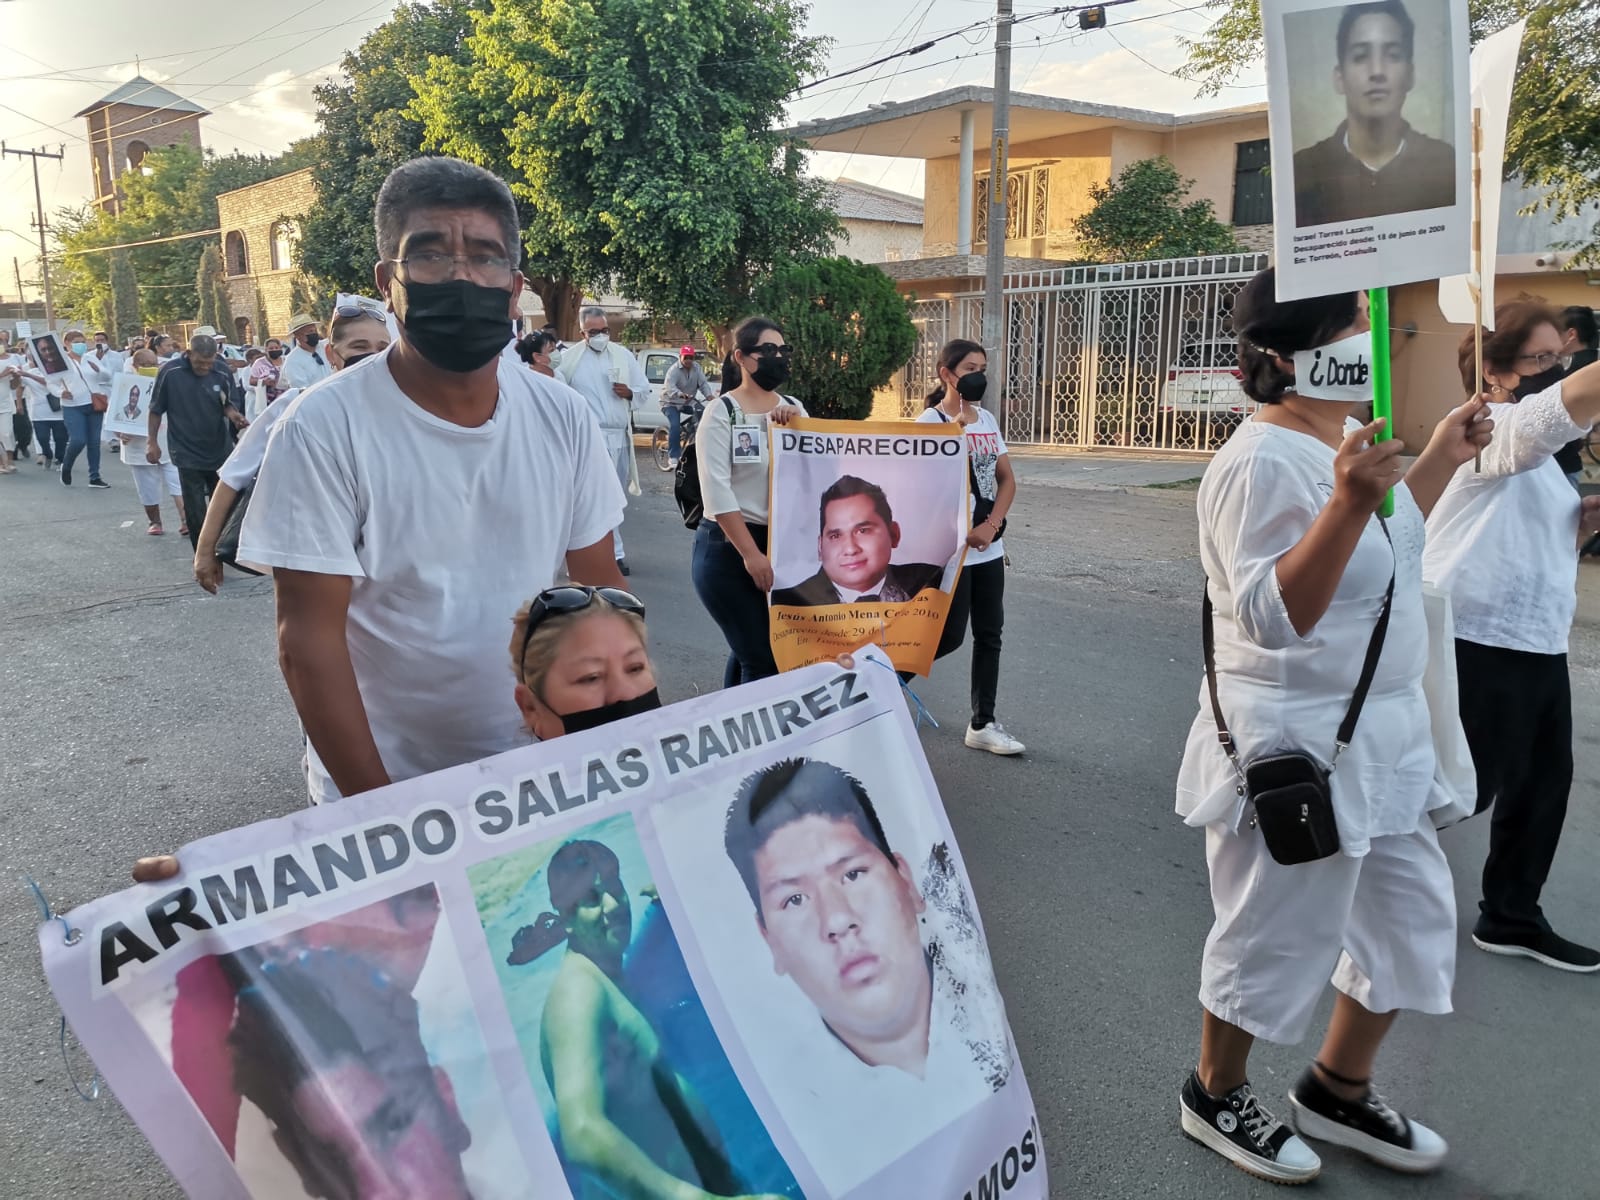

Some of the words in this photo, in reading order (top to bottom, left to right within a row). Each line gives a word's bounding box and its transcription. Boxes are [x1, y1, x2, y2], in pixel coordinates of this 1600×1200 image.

[1319, 230, 1343, 238] Torres
[1294, 240, 1347, 253] Desaparecido
[1343, 246, 1377, 257] Coahuila
[781, 433, 961, 456] DESAPARECIDO
[812, 611, 846, 622] Antonio
[849, 609, 880, 620] Mena
[852, 627, 865, 637] 29
[100, 809, 457, 985] ARMANDO
[475, 747, 649, 835] SALAS
[660, 672, 869, 773] RAMIREZ
